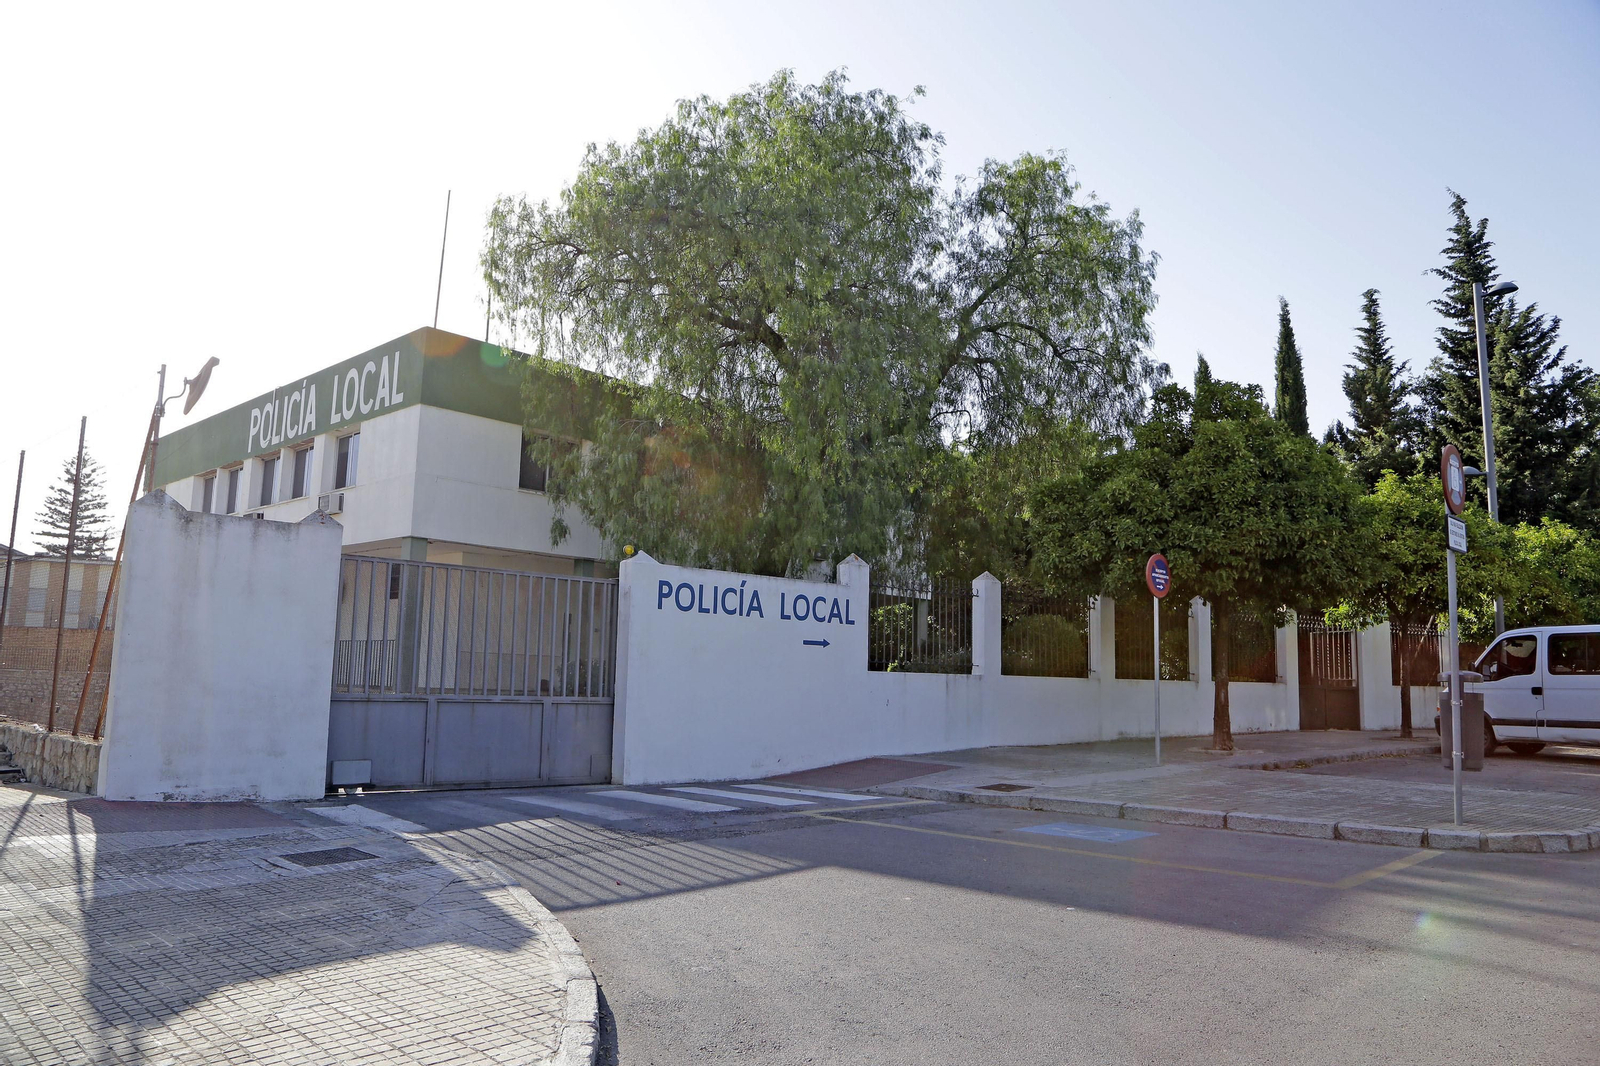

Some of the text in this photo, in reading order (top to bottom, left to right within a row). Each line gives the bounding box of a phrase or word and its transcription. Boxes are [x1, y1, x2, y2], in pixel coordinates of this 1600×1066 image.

[247, 350, 404, 454] POLICÍA LOCAL
[657, 580, 856, 626] POLICÍA LOCAL
